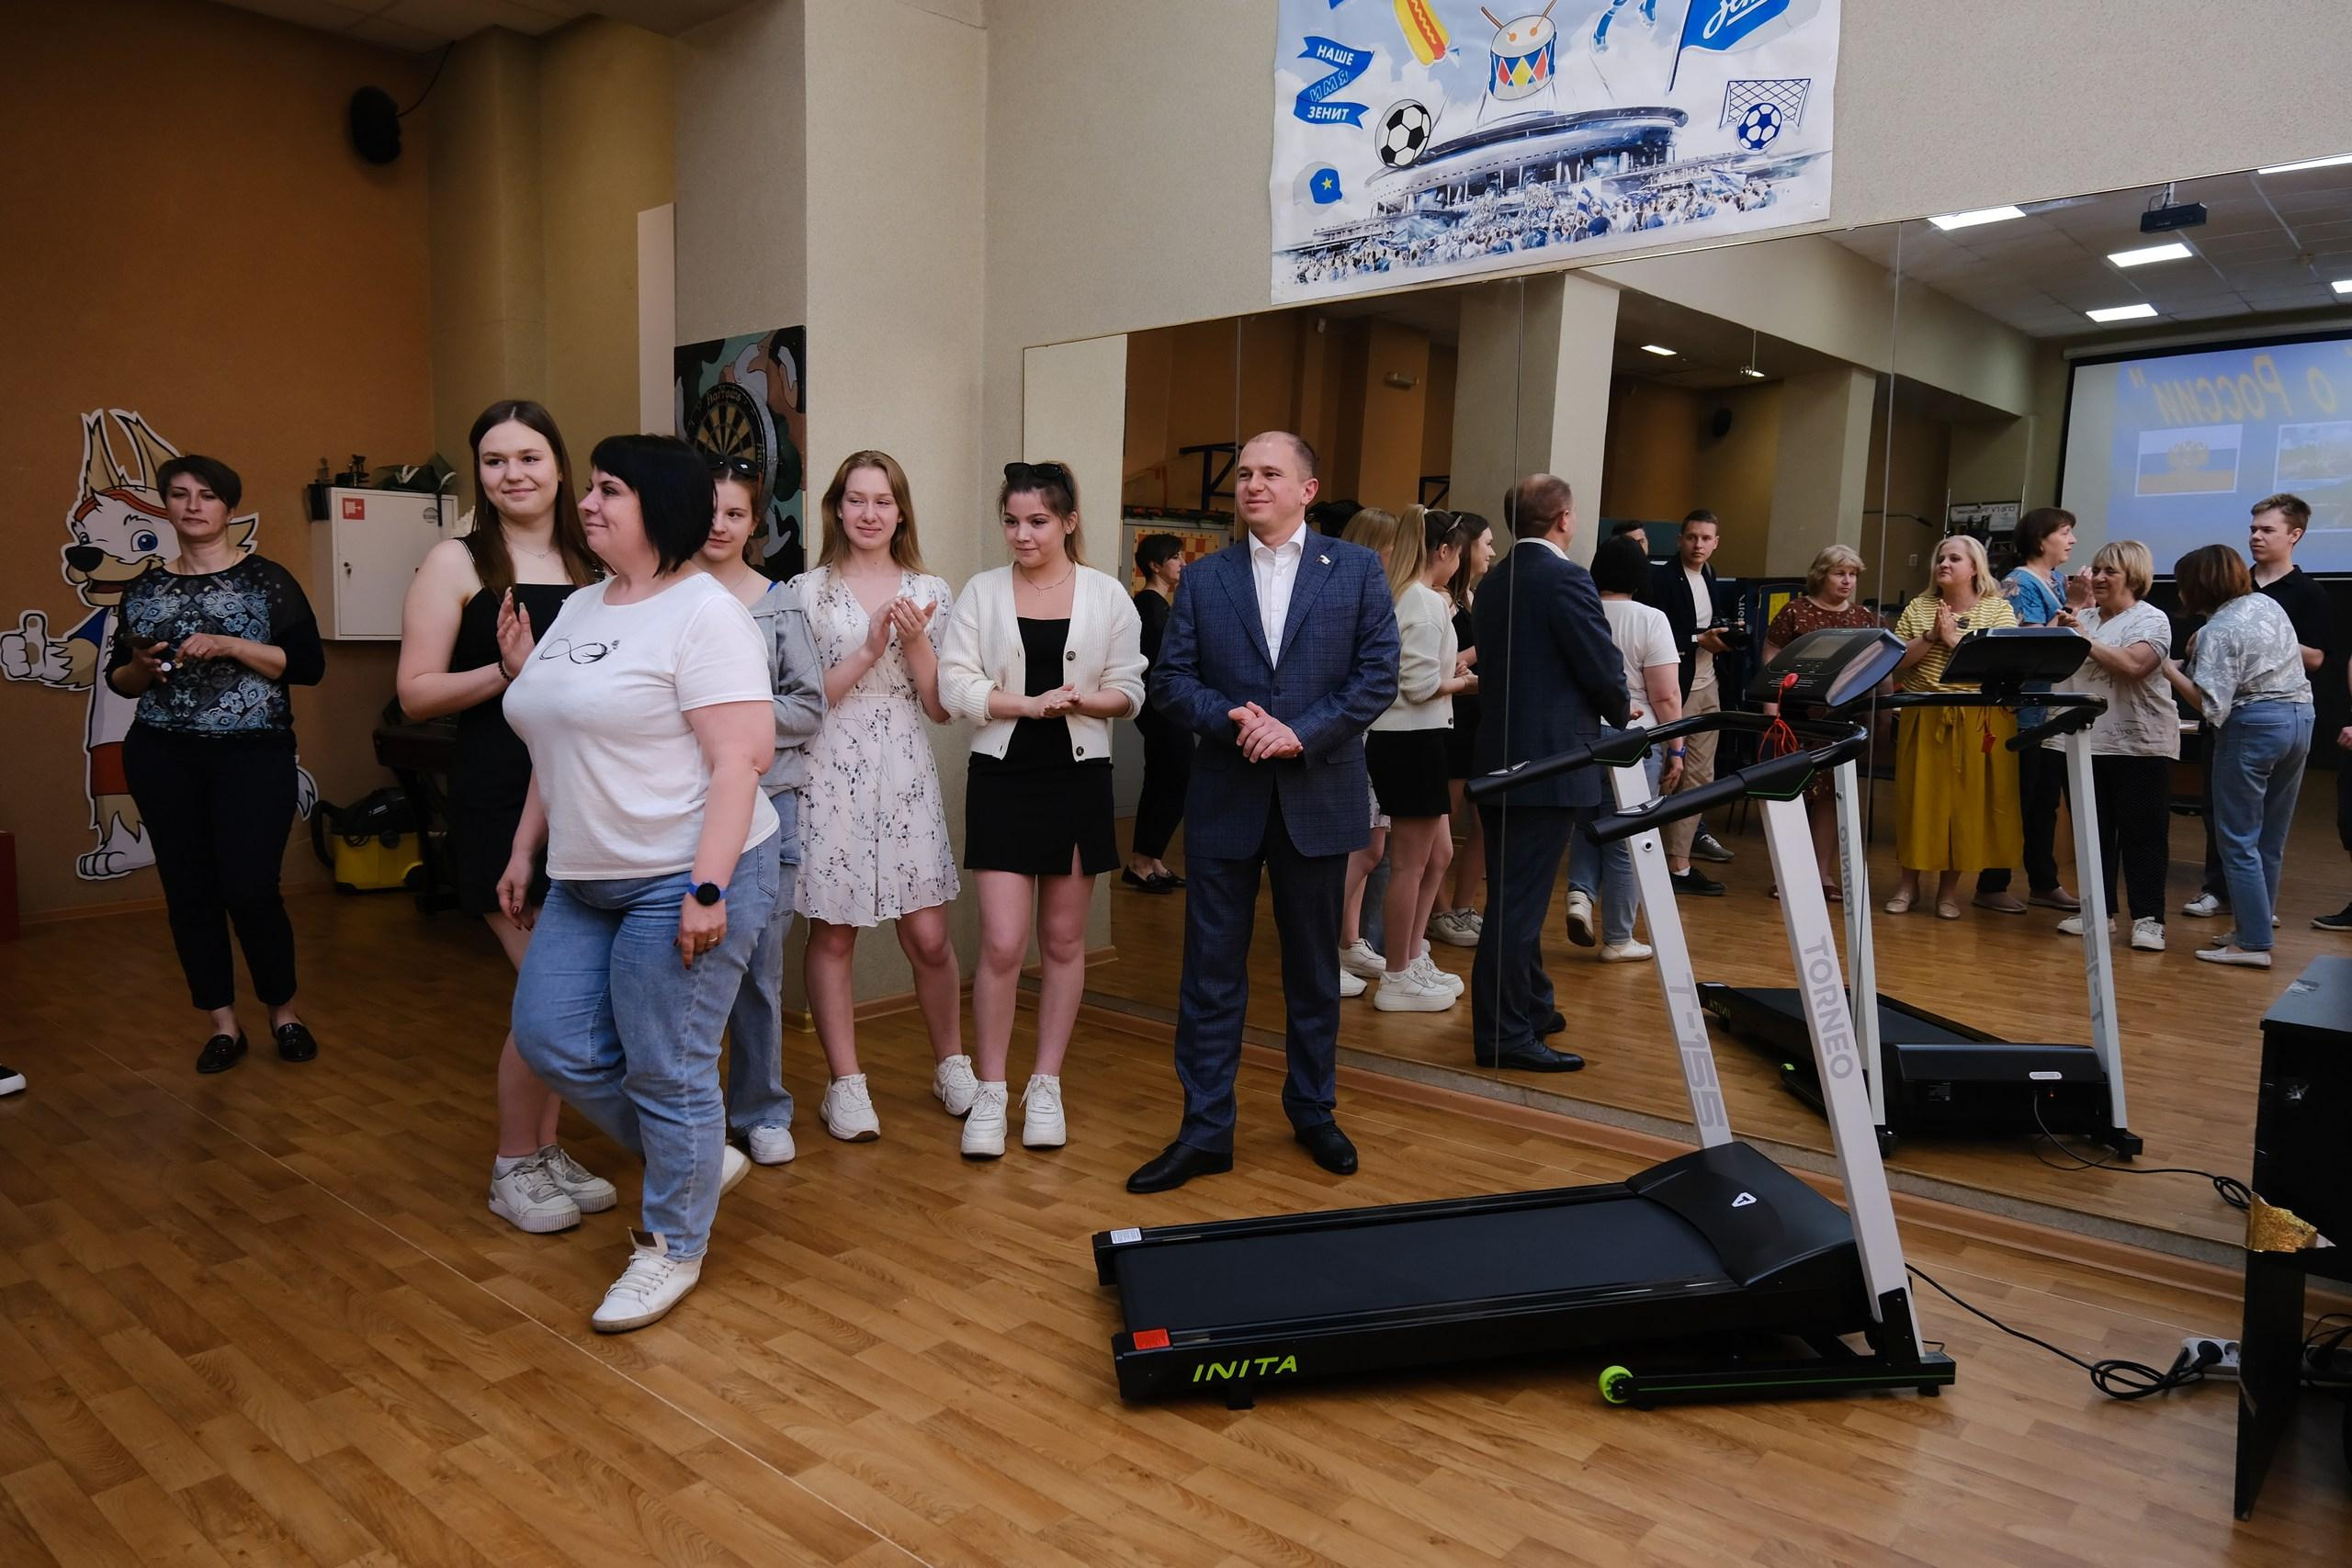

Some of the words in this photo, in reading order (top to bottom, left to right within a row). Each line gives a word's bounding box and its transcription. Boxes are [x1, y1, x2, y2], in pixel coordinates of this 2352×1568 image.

[1317, 44, 1354, 66] НАШЕ
[1309, 70, 1349, 103] ИМЯ
[1307, 106, 1349, 121] ЗЕНИТ
[1803, 934, 1853, 1079] TORNEO
[1668, 971, 1725, 1128] T-155
[1193, 1355, 1297, 1382] INITA
